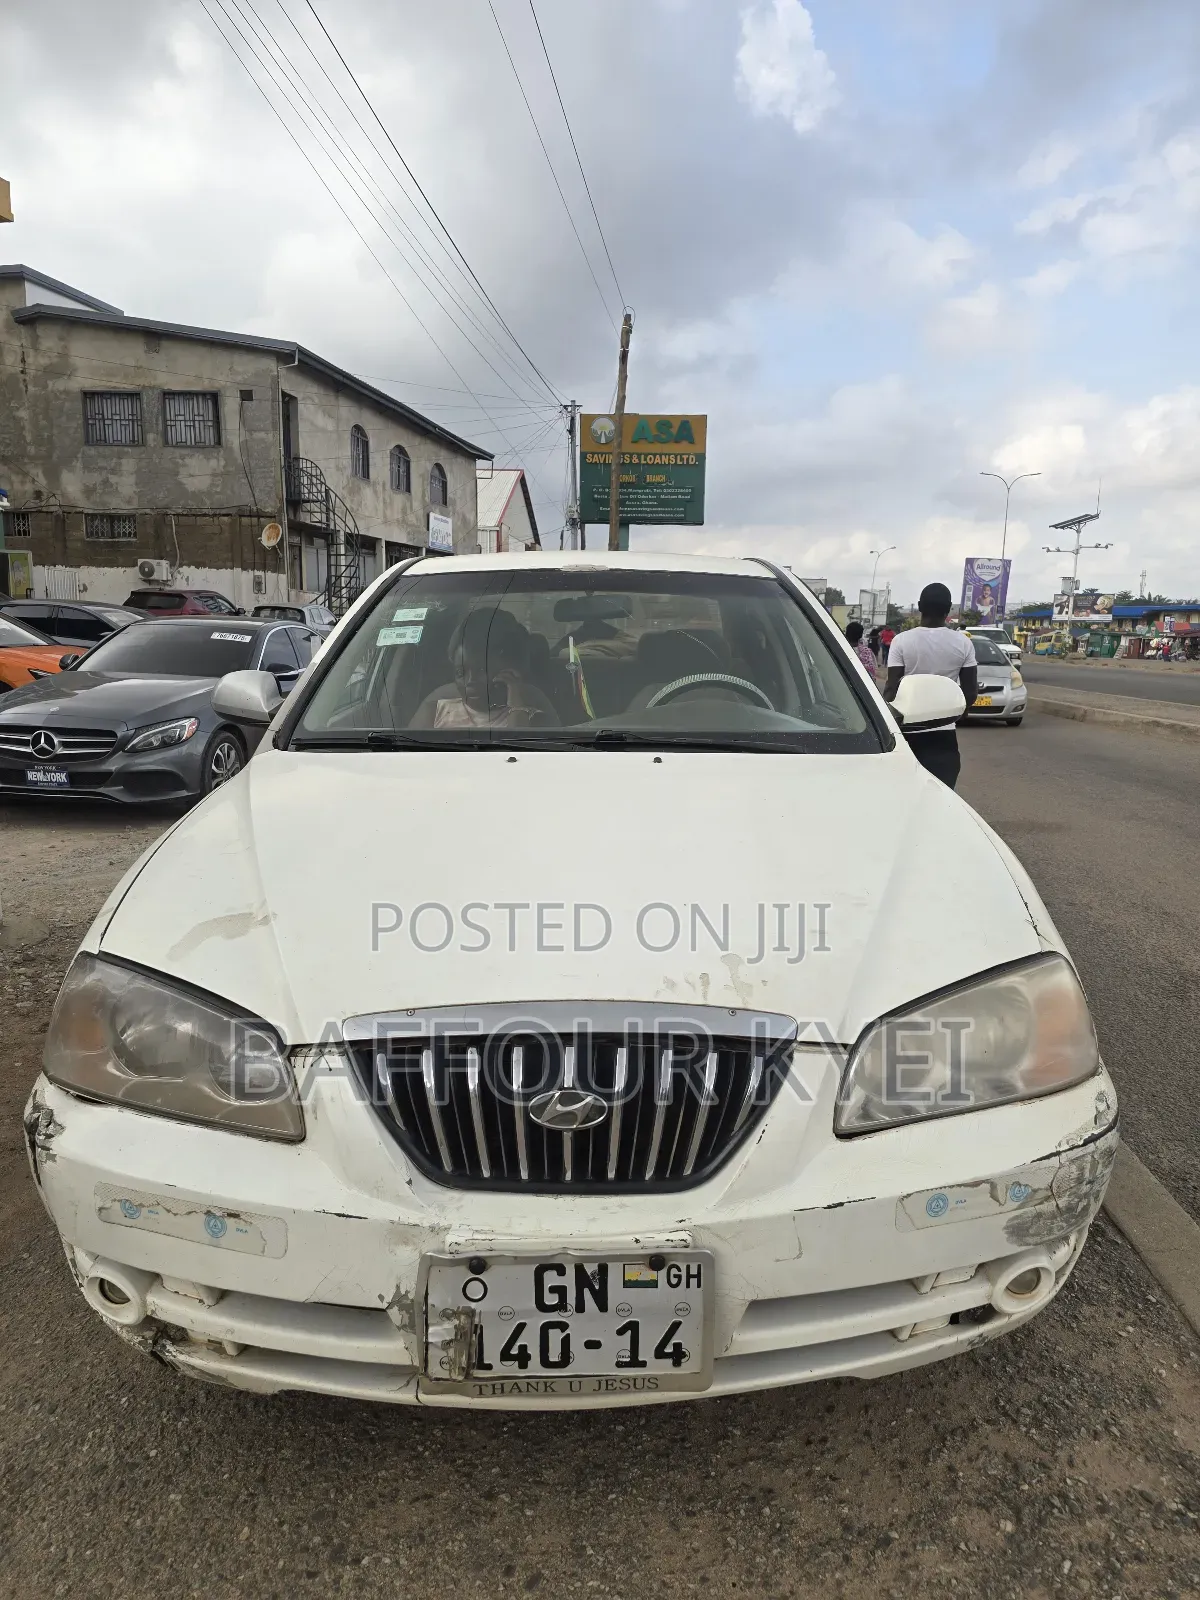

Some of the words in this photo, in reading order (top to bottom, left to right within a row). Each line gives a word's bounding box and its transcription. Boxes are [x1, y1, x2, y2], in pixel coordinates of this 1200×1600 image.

[631, 419, 696, 444] ASA
[631, 454, 639, 464] &
[641, 454, 675, 465] LOANS
[677, 454, 699, 465] LTD.
[646, 474, 667, 483] BRANCH
[976, 563, 1001, 572] Allround
[27, 770, 43, 782] NEW
[46, 772, 68, 783] YORK
[534, 1263, 609, 1314] GN
[666, 1263, 702, 1289] GH
[473, 1380, 557, 1397] THANK
[568, 1380, 582, 1393] U
[592, 1377, 660, 1392] JESUS
